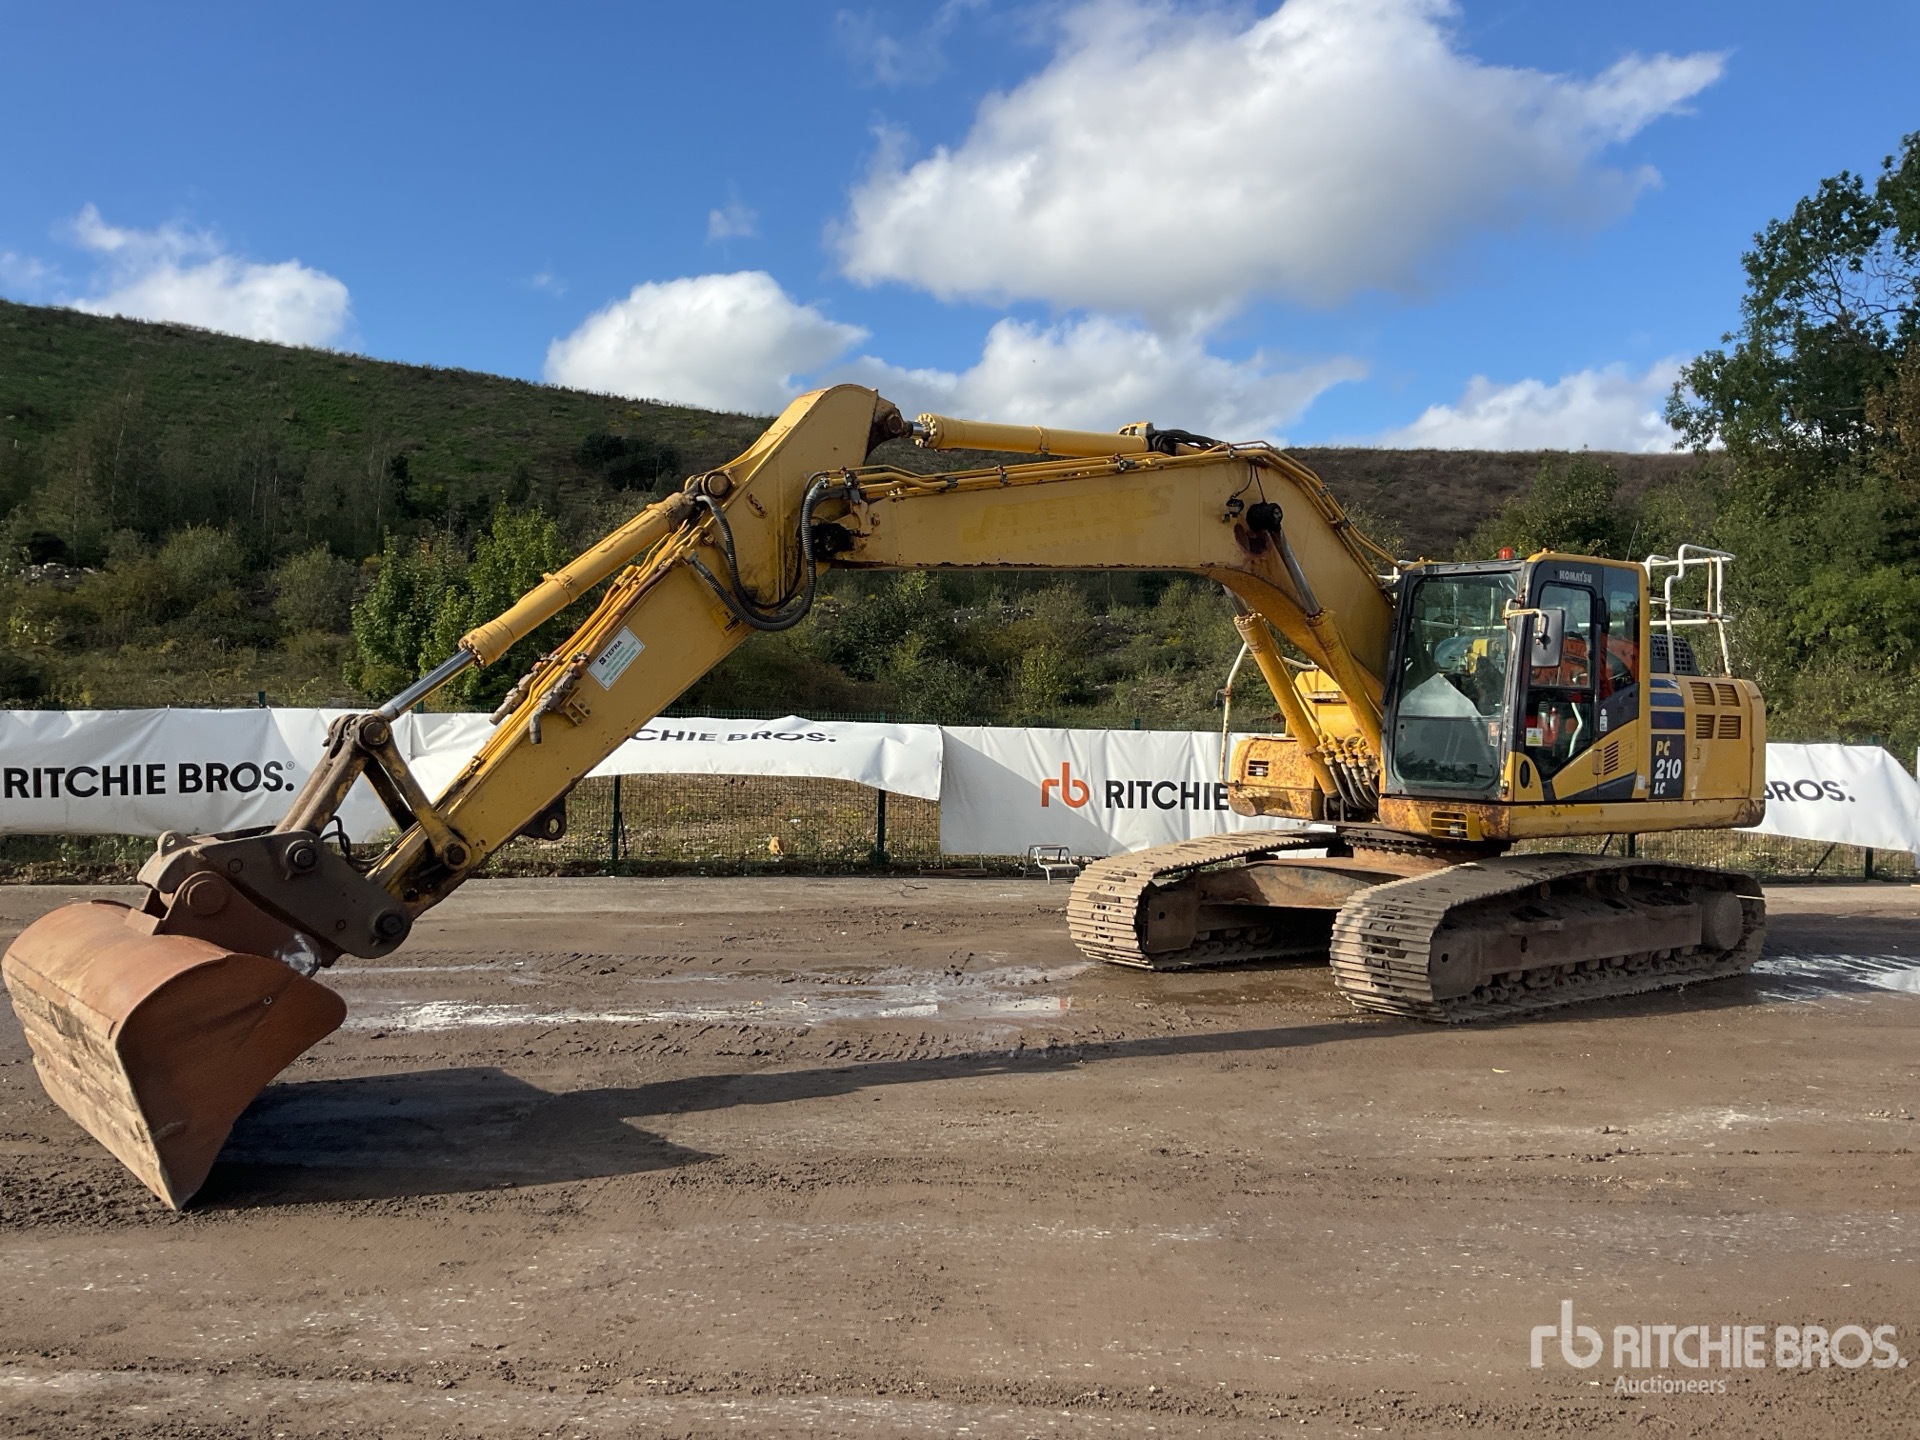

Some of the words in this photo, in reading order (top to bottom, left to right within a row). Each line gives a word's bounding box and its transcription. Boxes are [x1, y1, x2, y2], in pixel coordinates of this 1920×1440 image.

[1559, 569, 1592, 583] KOMATSU
[604, 640, 623, 659] TEFRA
[630, 728, 718, 742] CHIE
[1655, 740, 1670, 756] PC
[1654, 758, 1682, 779] 210
[4, 763, 166, 798] RITCHIE
[1105, 779, 1229, 811] RITCHIE
